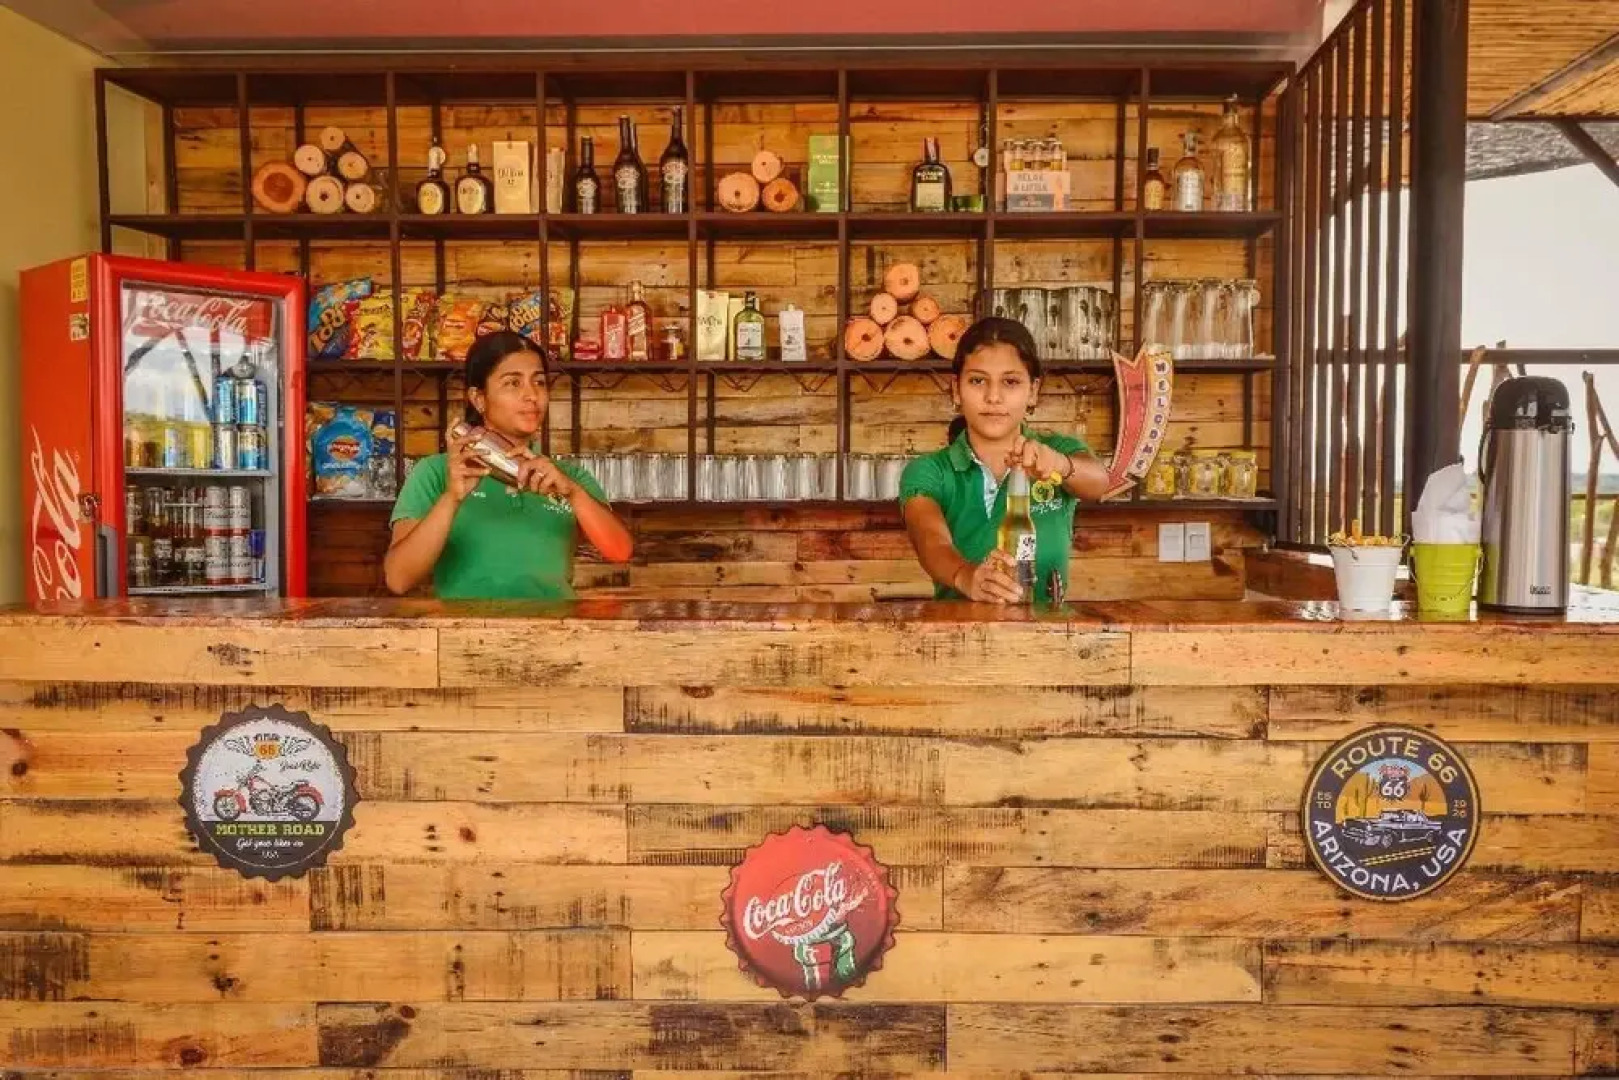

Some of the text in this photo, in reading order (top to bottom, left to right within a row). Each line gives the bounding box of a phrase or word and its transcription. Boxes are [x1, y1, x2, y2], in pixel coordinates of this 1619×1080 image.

[1135, 359, 1167, 471] WELCOME
[1330, 736, 1458, 784] ROUTE 66
[1381, 780, 1406, 798] 66
[216, 823, 325, 835] MOTHER ROAD
[1313, 820, 1467, 893] ARIZONA, USA
